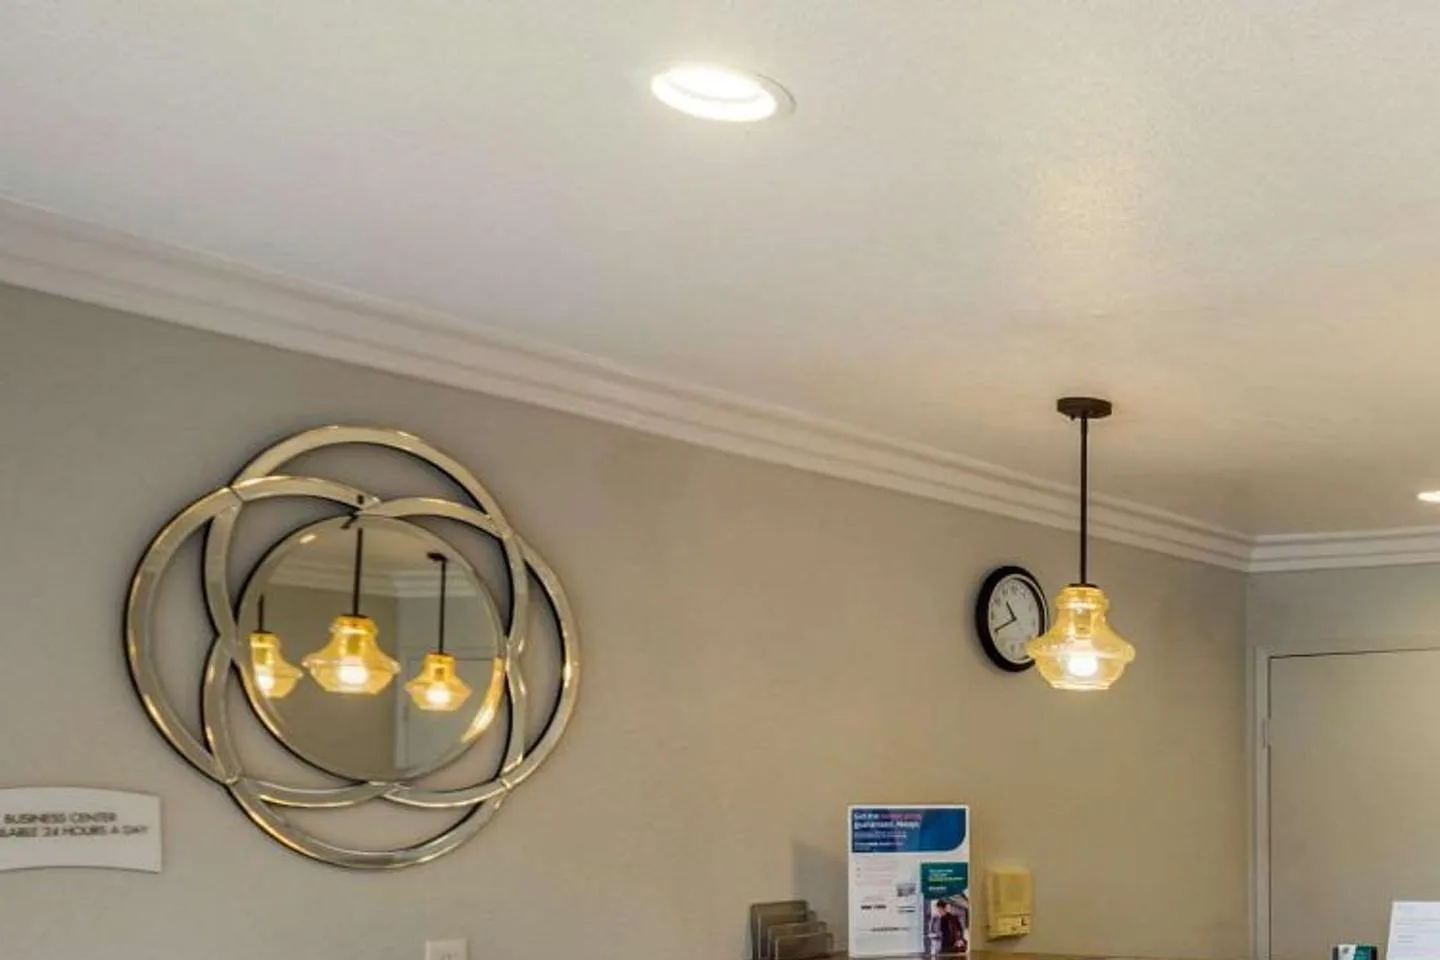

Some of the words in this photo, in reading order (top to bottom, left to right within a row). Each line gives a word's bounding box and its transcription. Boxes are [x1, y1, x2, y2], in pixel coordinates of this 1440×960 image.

[4, 813, 67, 824] BUSINESS
[69, 812, 117, 823] CENTER
[62, 825, 107, 836] HOURS
[110, 825, 120, 834] A
